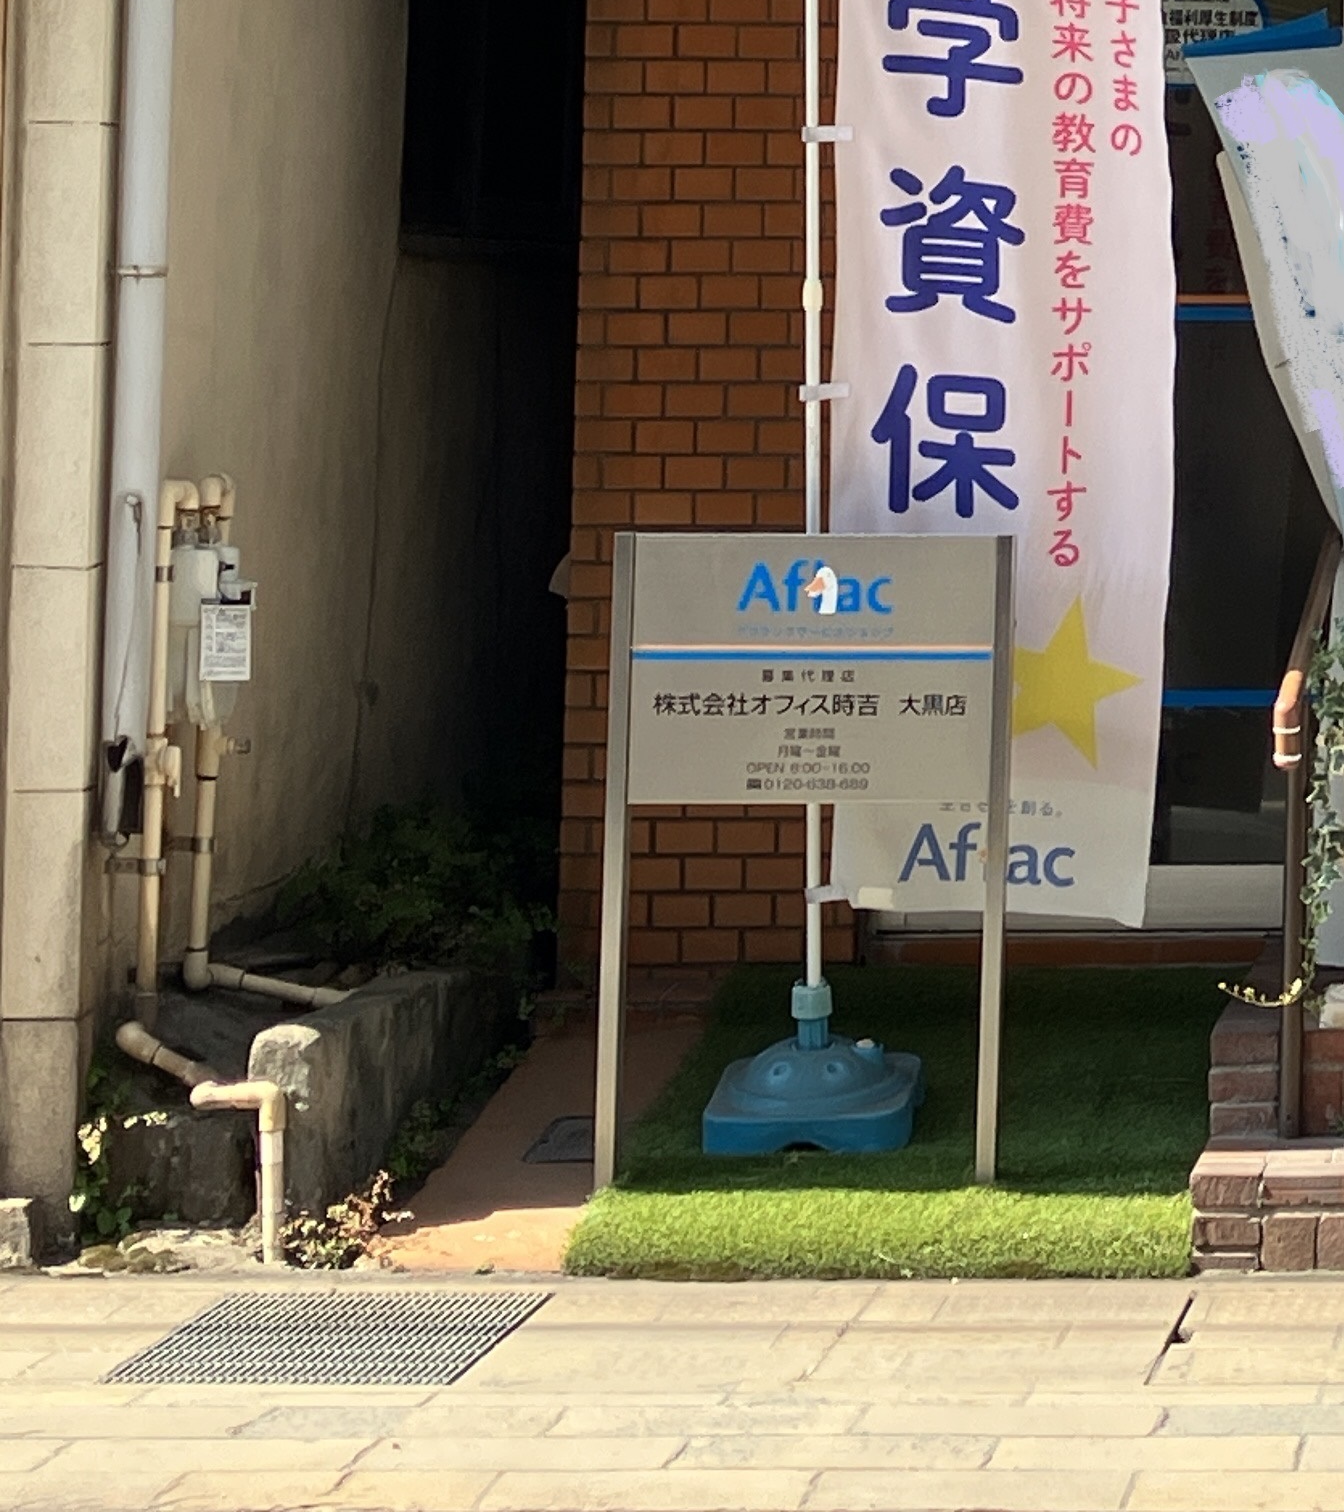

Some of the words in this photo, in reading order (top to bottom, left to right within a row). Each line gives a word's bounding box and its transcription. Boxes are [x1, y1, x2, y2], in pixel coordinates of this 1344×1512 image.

[736, 558, 893, 616] Aflac
[653, 692, 880, 717] 株式会社オフィス時吉
[898, 693, 967, 717] 大黒店
[746, 761, 785, 775] OPEN
[897, 821, 1076, 888] Afac
